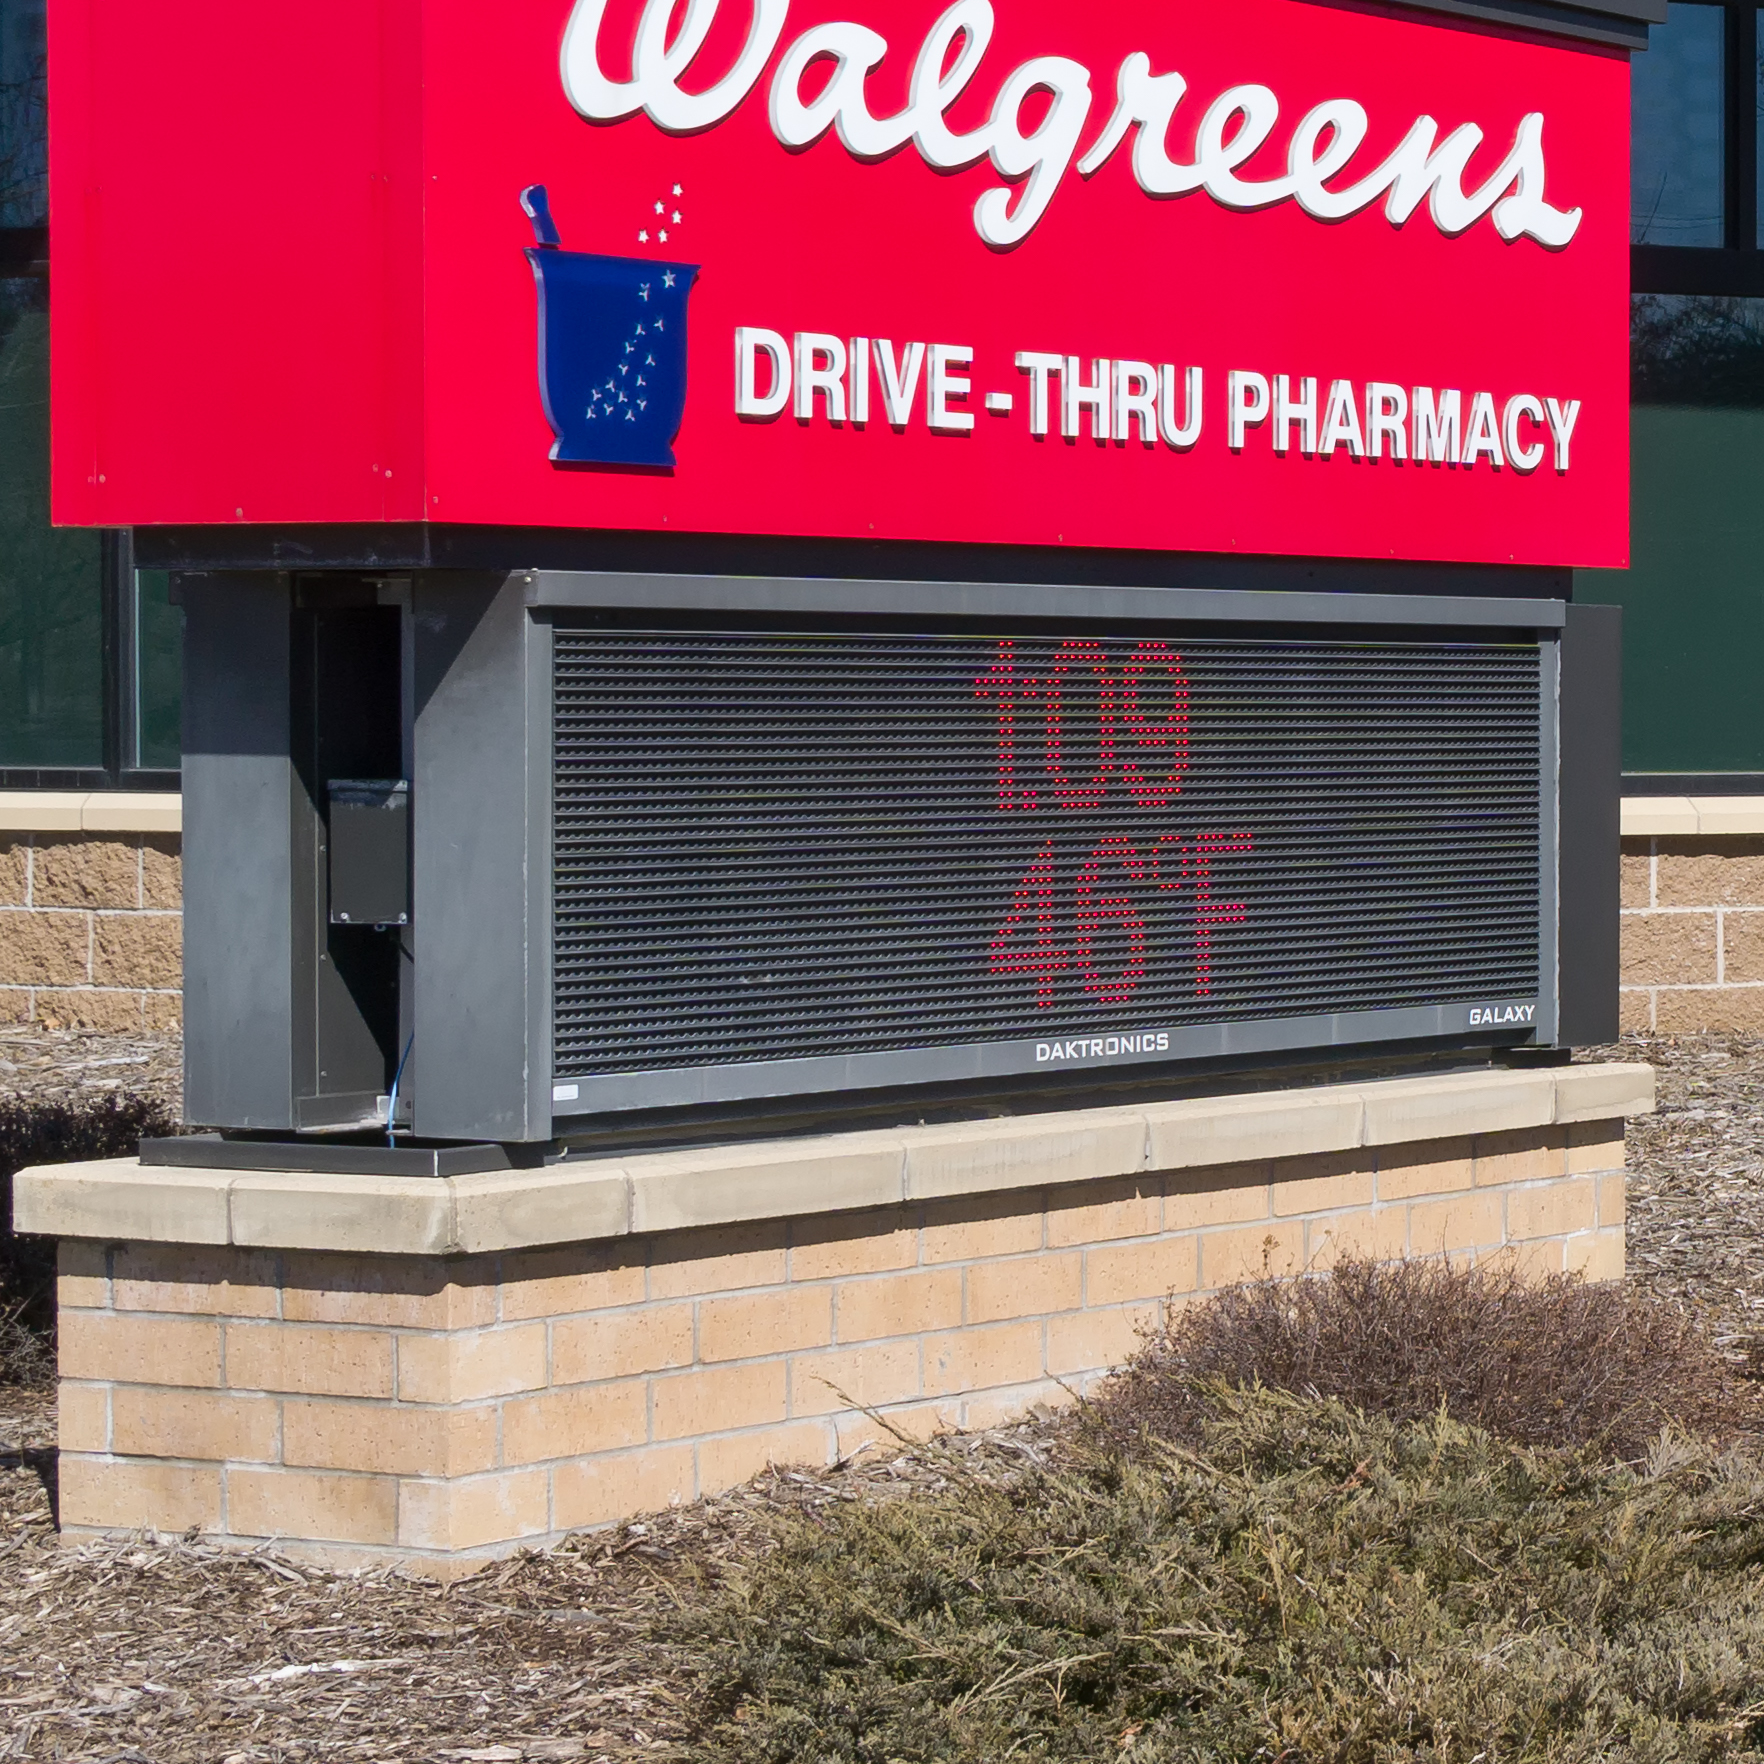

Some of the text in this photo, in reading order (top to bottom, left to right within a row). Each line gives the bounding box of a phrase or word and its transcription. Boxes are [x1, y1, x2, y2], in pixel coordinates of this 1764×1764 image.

[733, 326, 1582, 472] DRIVE-THRU PHARMACY
[1468, 1004, 1536, 1026] GALAXY
[1035, 1032, 1169, 1062] DAKTRONICS
